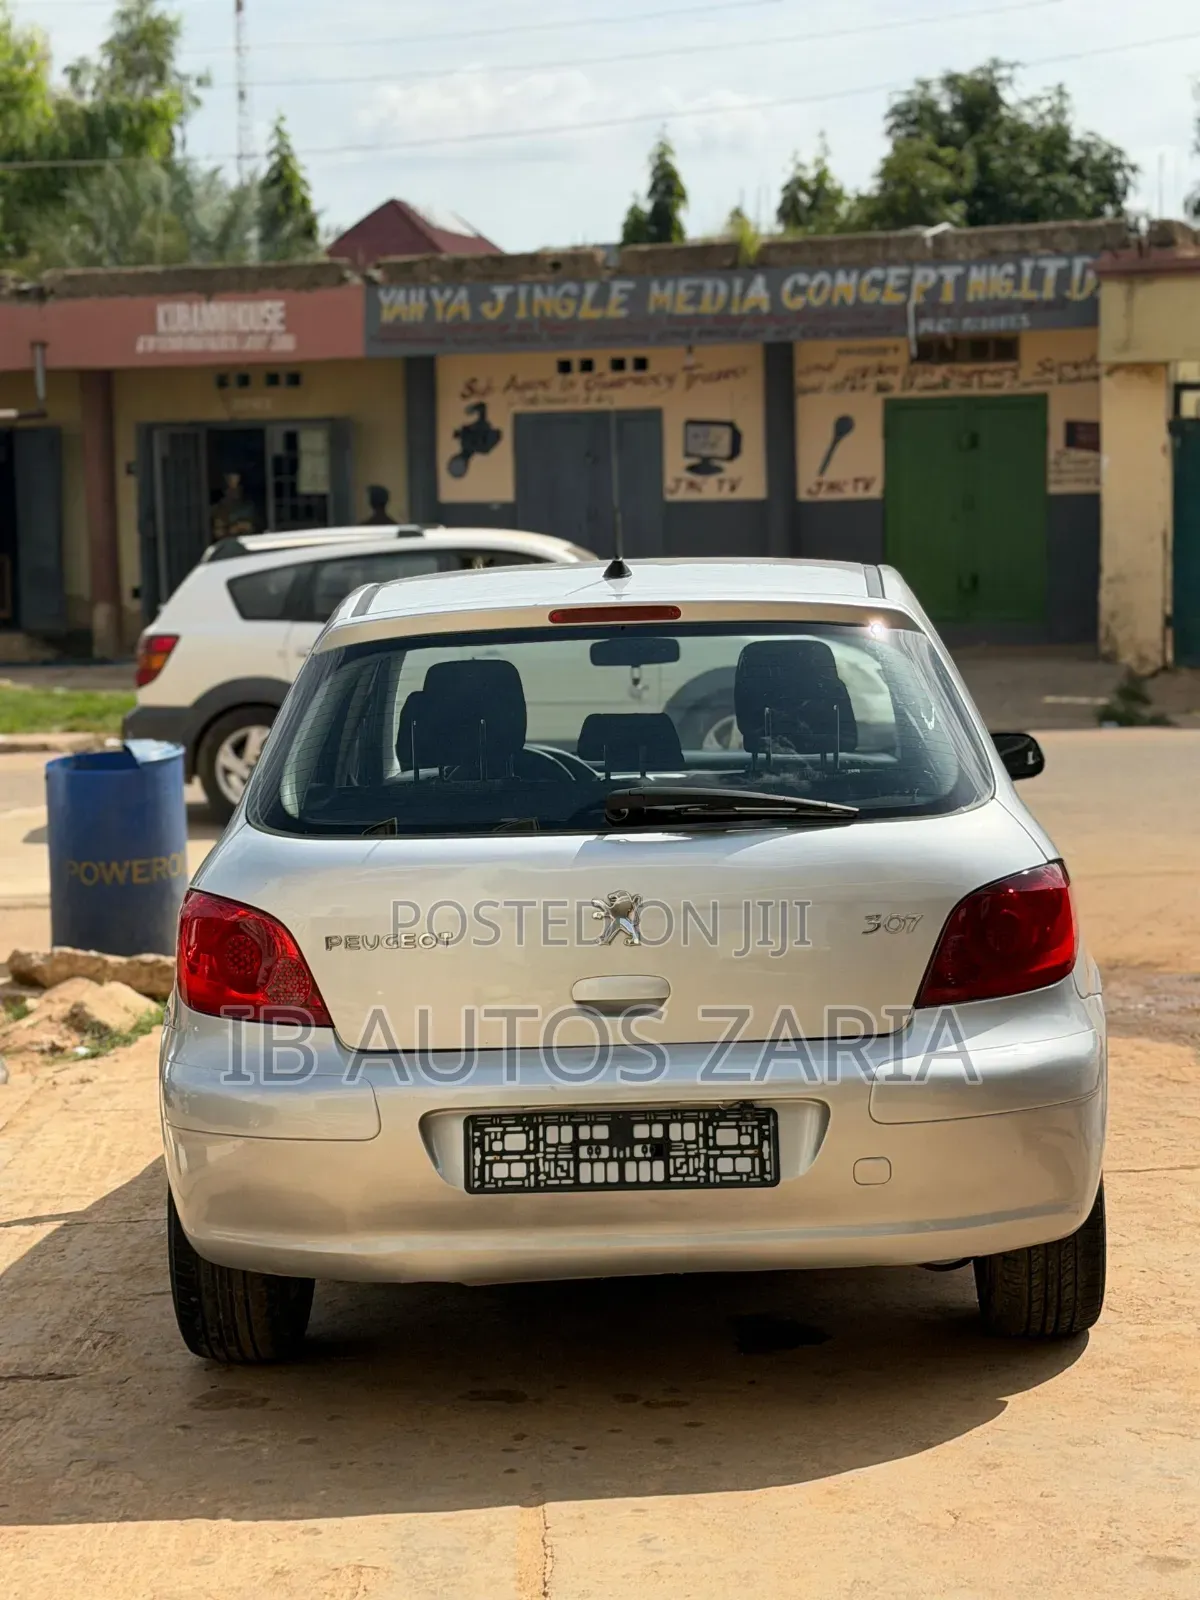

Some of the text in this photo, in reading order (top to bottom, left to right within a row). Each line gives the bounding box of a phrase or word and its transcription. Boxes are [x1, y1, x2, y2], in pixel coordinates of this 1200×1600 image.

[480, 278, 636, 321] JINGLE
[648, 274, 771, 315] MEDIA
[781, 264, 964, 310] CONCEPT
[862, 913, 924, 935] 307
[324, 931, 454, 951] PEUGEOT
